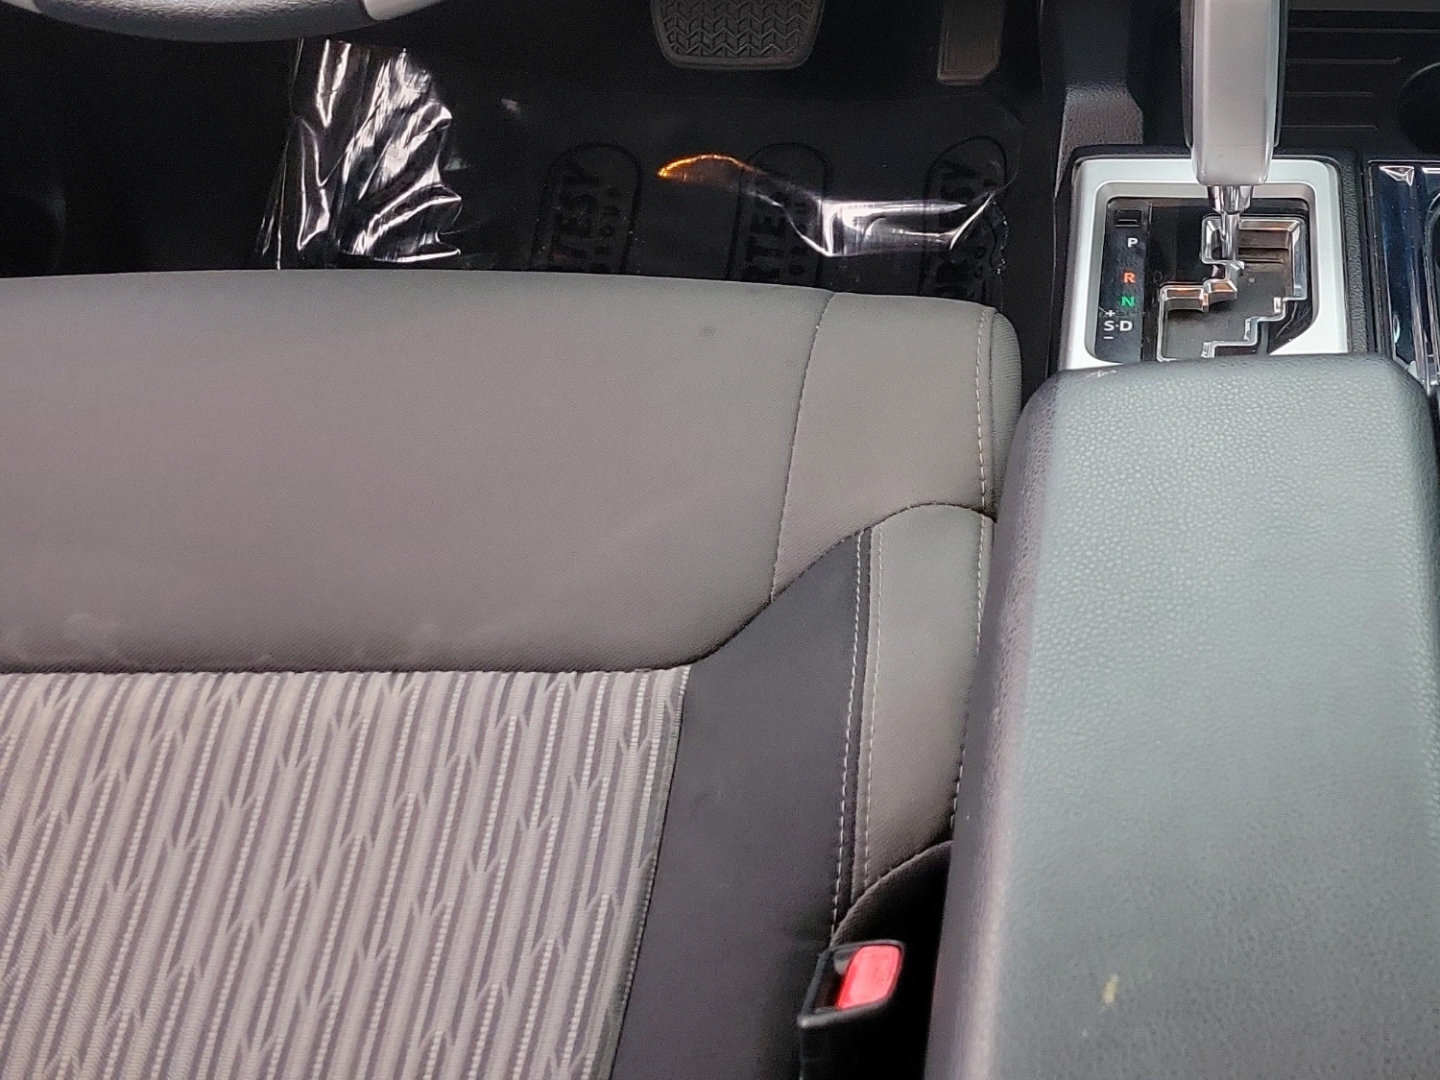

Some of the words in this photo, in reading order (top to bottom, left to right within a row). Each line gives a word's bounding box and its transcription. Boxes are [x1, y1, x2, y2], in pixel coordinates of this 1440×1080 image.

[1127, 237, 1139, 248] P
[1123, 272, 1135, 283] R
[1121, 296, 1135, 307] N
